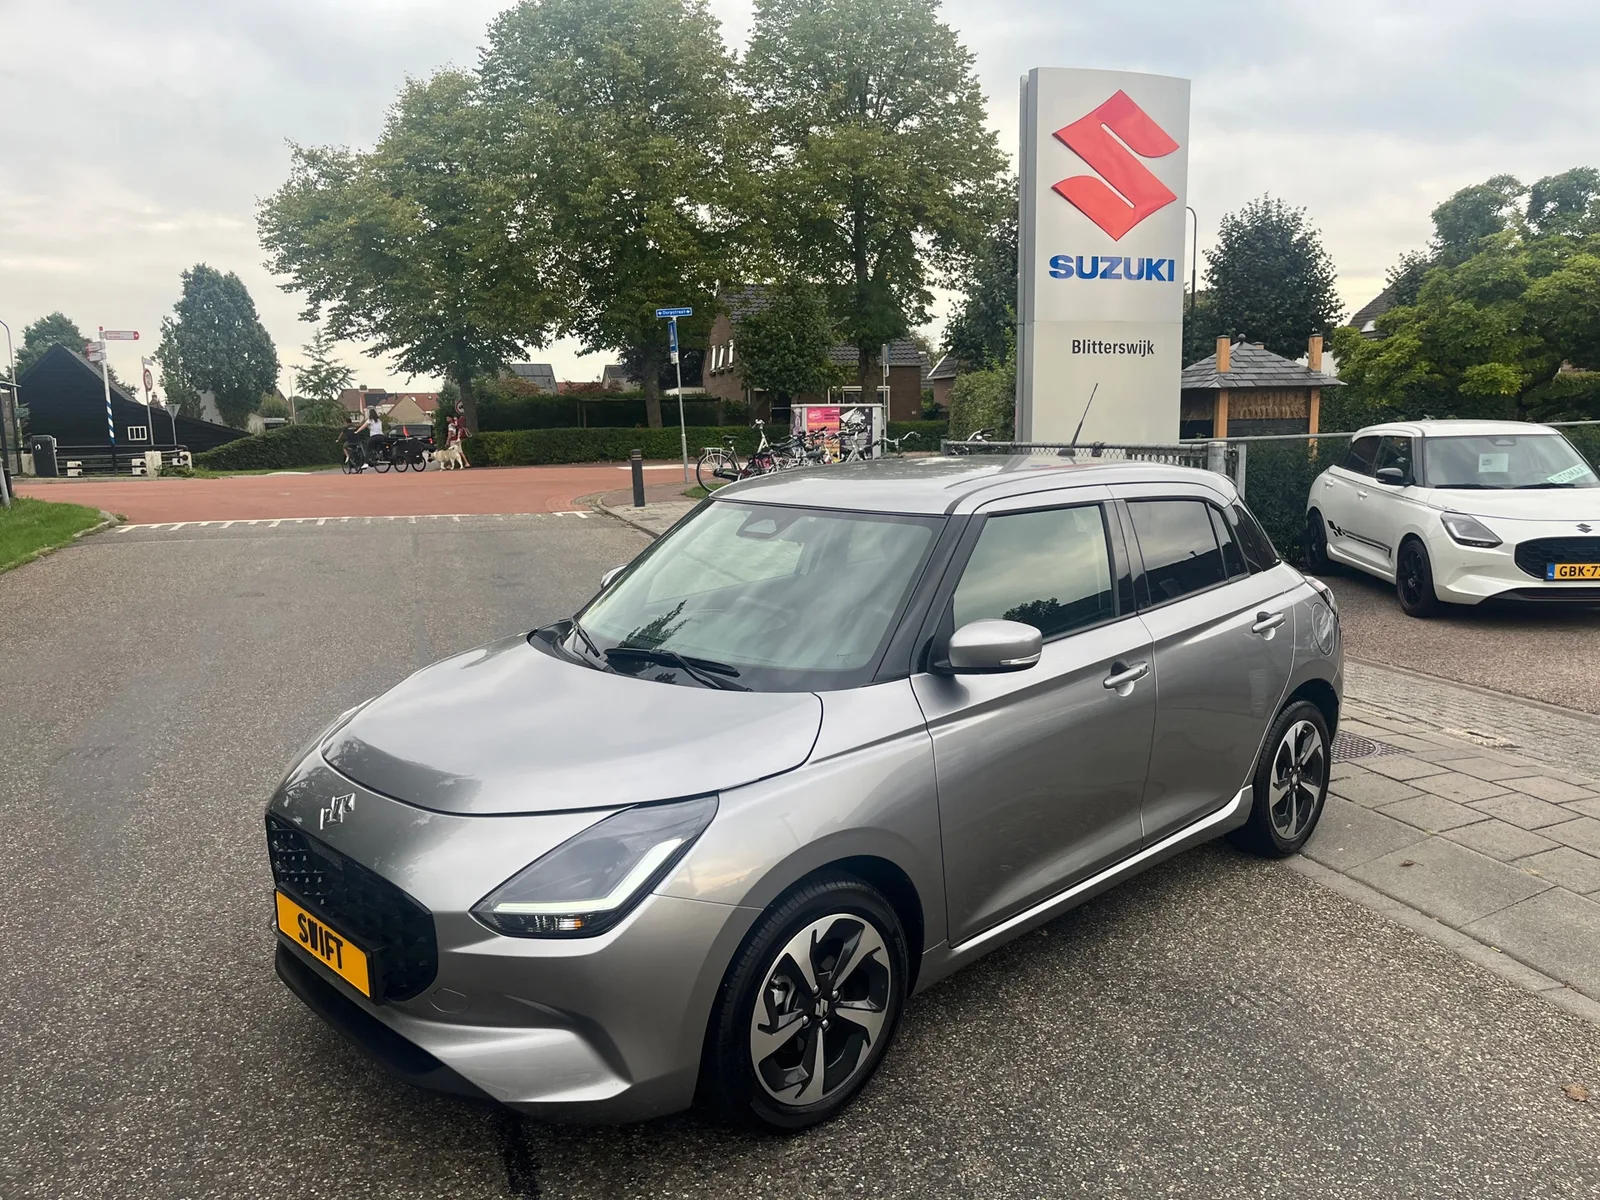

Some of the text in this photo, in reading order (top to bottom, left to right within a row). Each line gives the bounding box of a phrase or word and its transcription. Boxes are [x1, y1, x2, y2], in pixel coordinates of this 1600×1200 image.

[1049, 254, 1175, 282] SUZUKI
[1072, 339, 1155, 358] Blitterswijk
[1559, 565, 1600, 577] GBK-7
[297, 912, 344, 970] SWIFT
